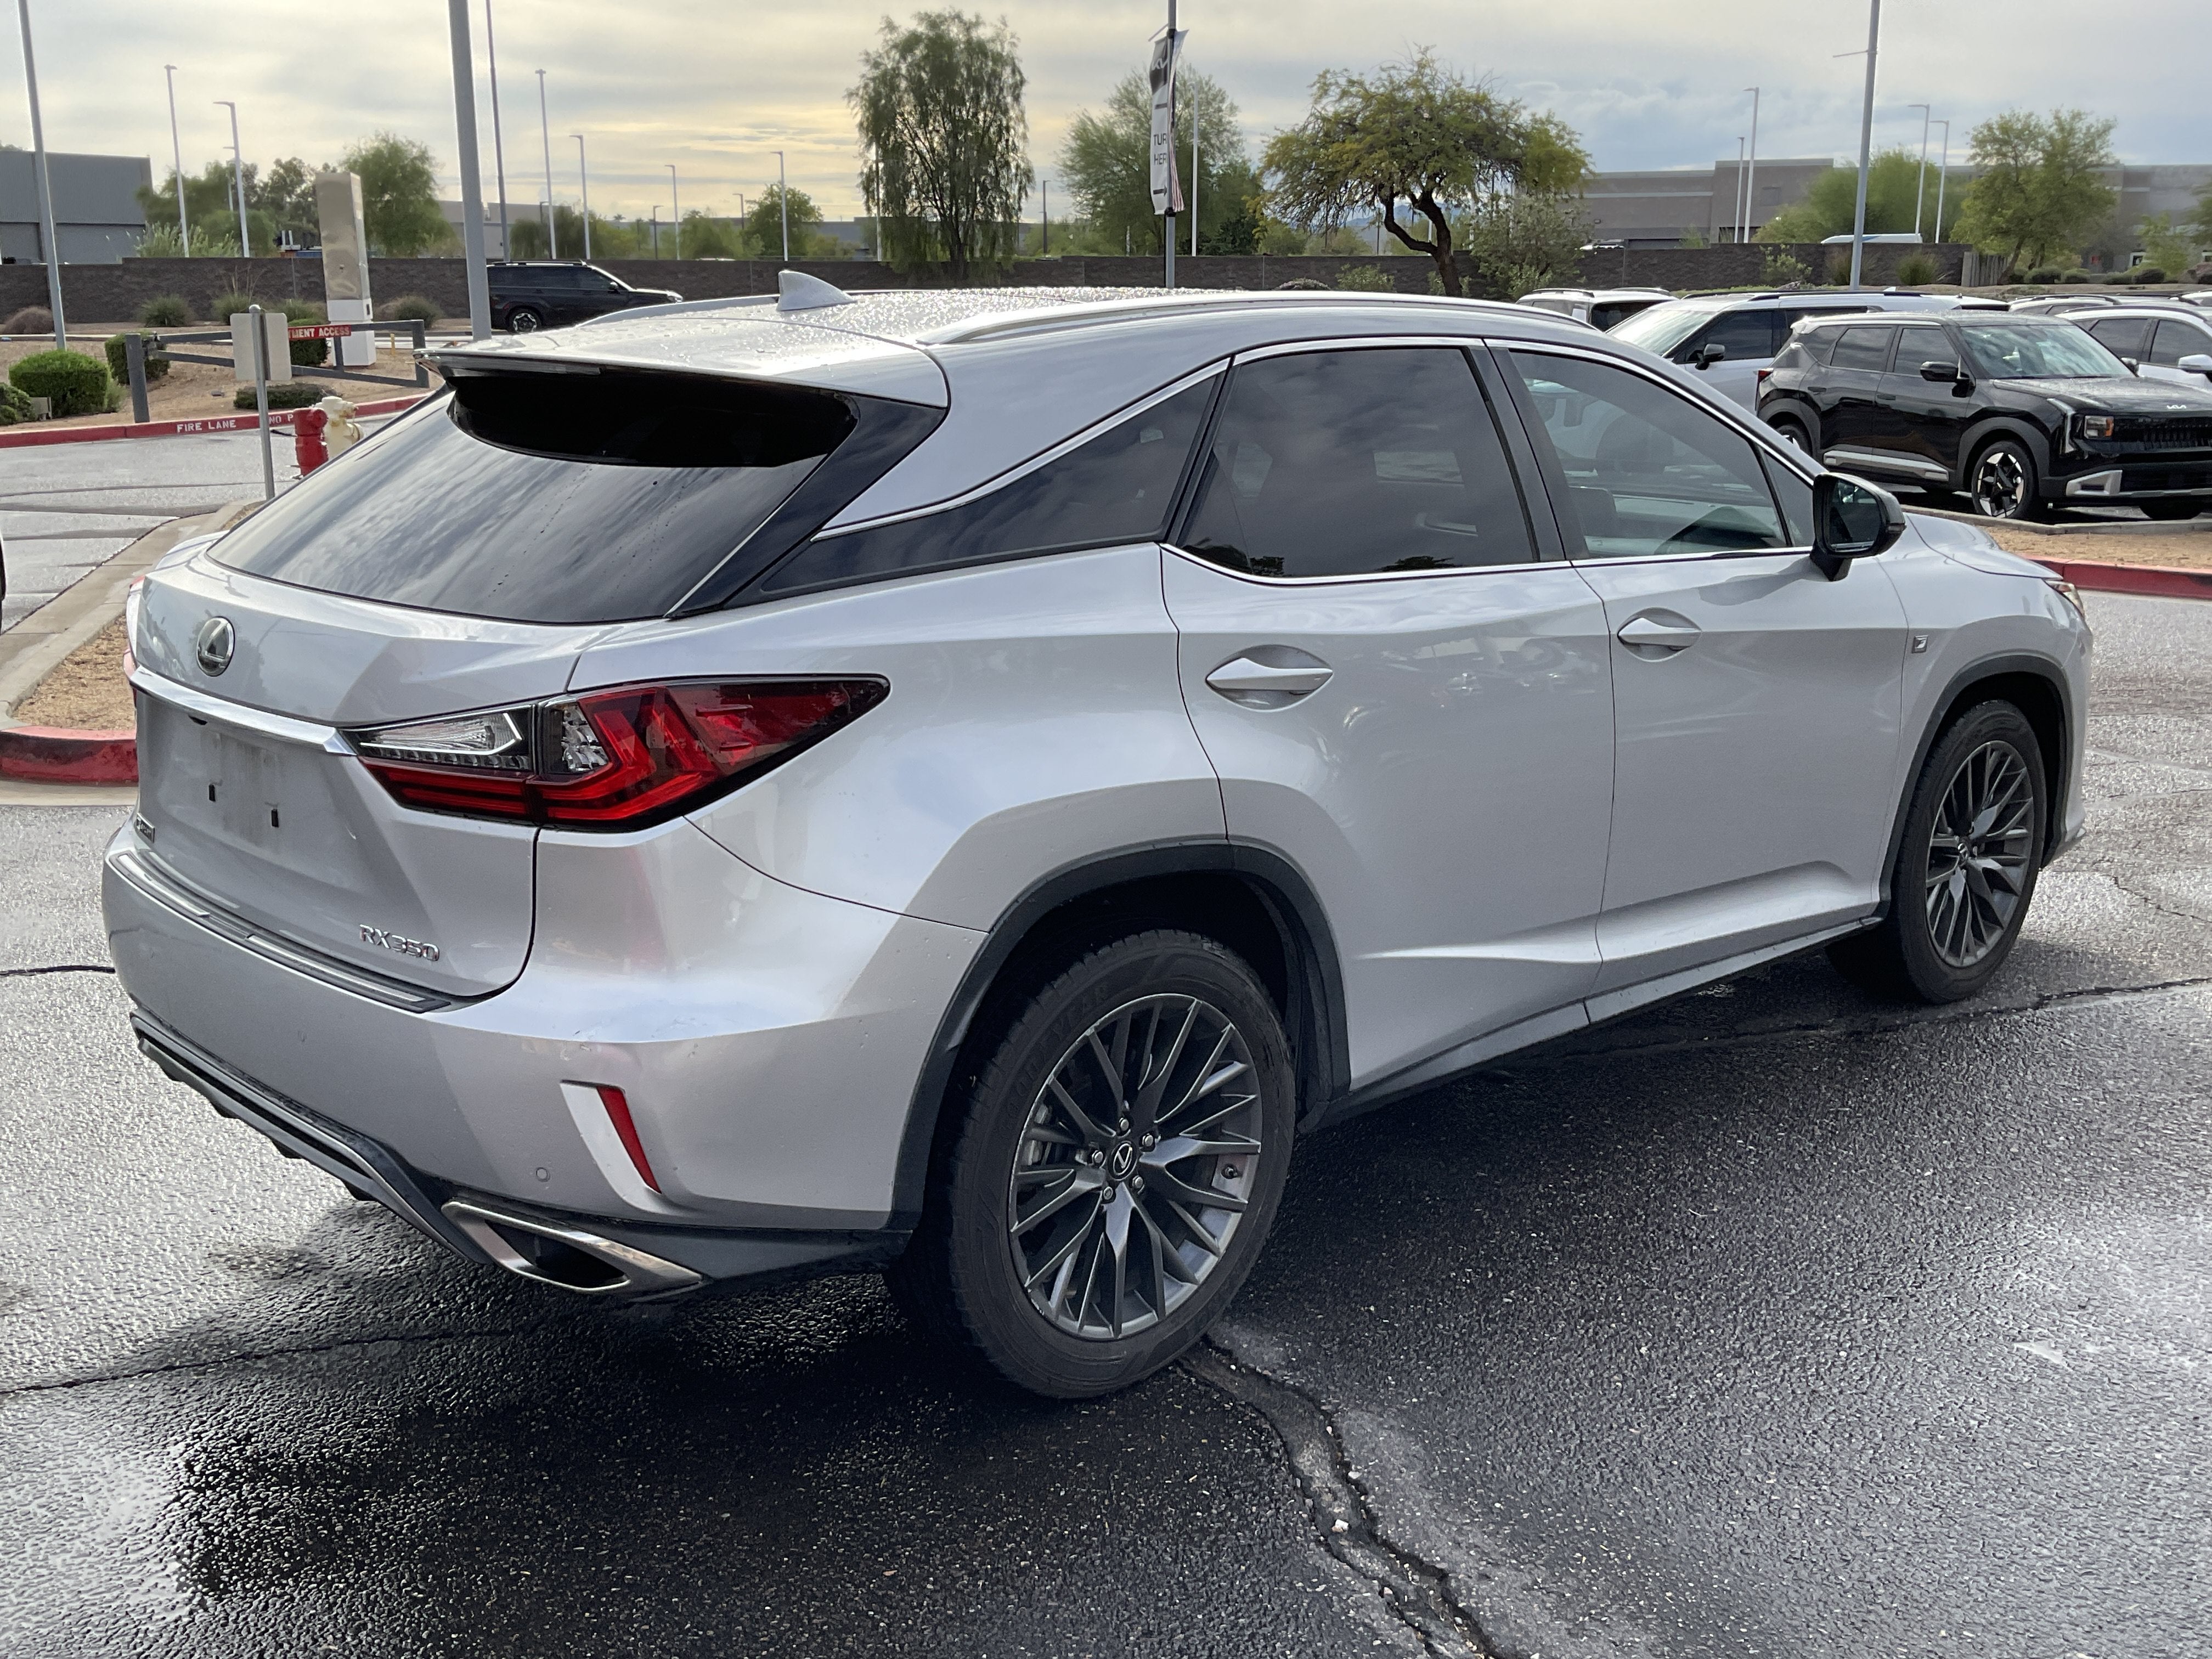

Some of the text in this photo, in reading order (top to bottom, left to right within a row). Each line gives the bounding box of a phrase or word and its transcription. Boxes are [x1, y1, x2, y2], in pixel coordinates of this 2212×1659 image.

[319, 326, 349, 337] ACCESS
[177, 422, 202, 433] FIRE
[208, 420, 236, 430] LANE
[269, 415, 281, 424] NO
